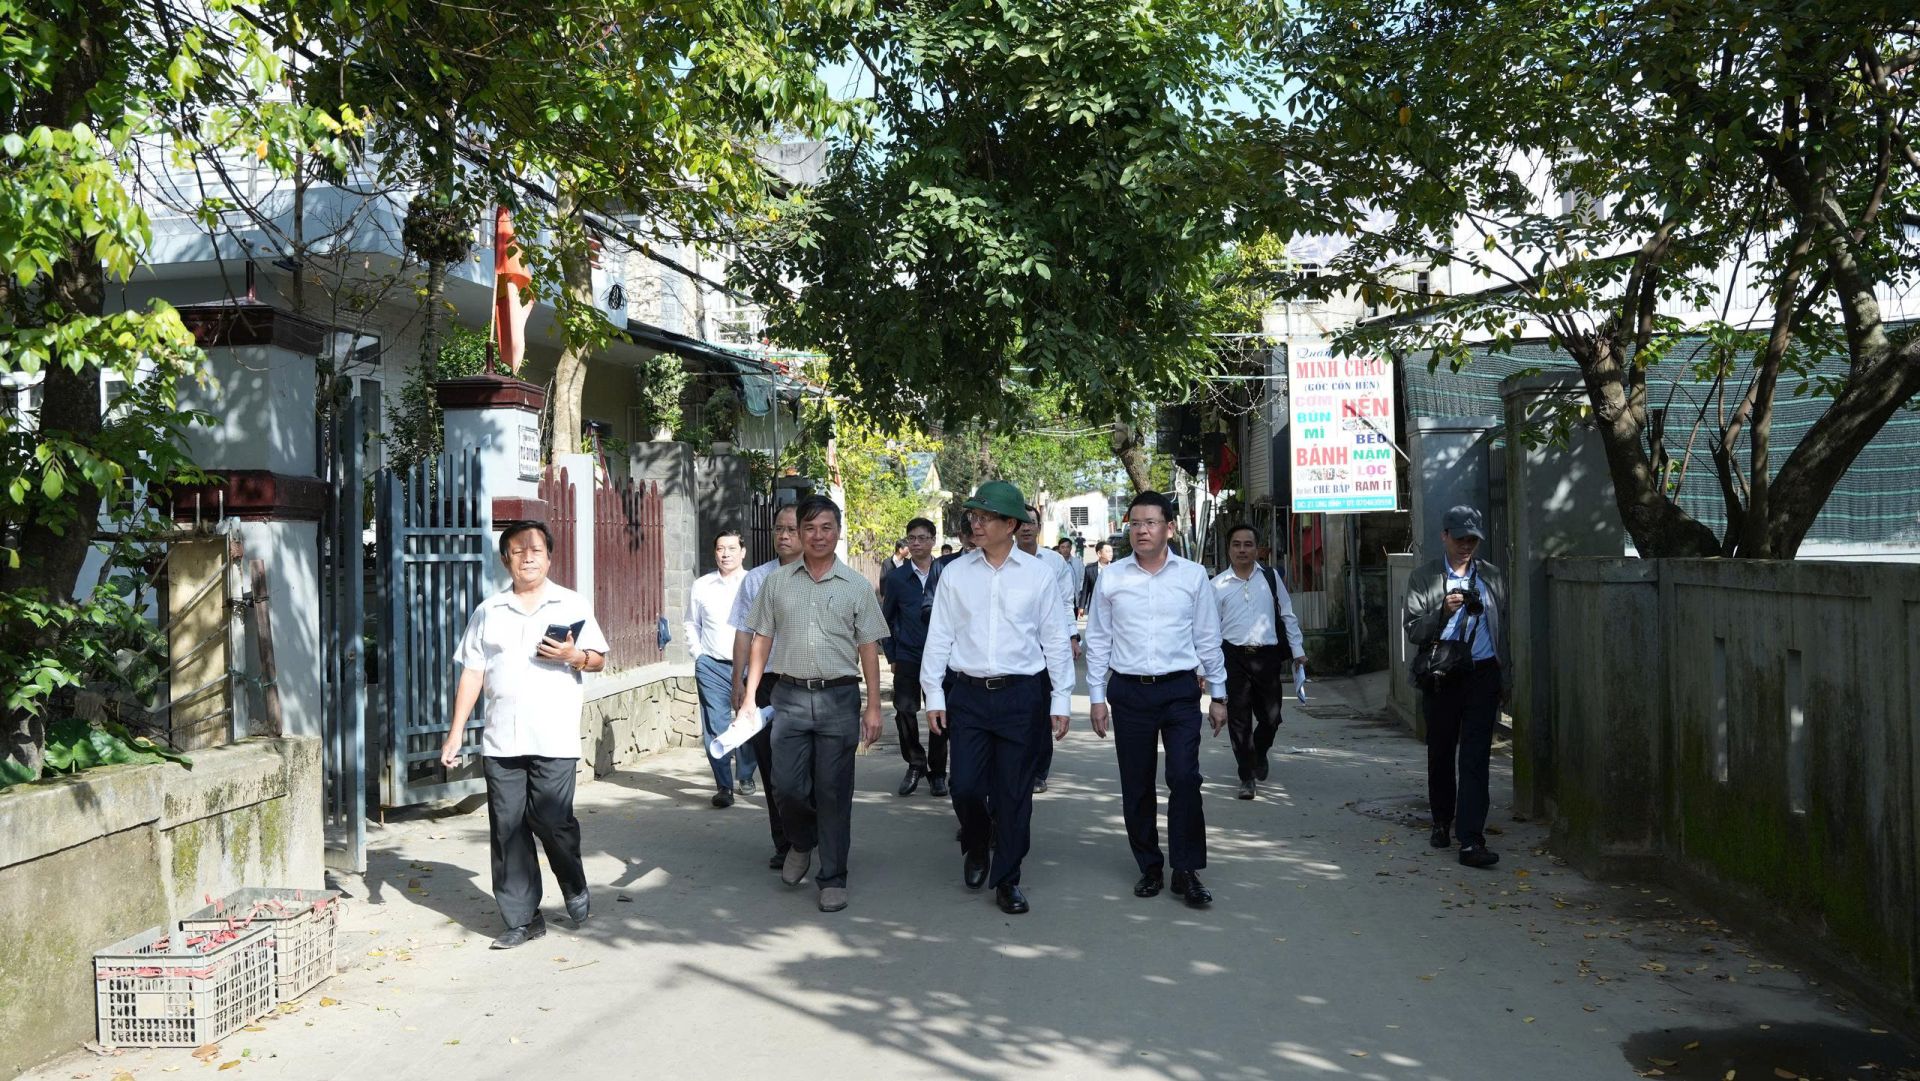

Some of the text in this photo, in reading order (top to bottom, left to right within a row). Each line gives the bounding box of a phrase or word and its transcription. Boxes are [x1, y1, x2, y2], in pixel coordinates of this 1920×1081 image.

[1296, 361, 1338, 379] MINH
[1342, 392, 1389, 418] HẾN
[1296, 443, 1348, 466] BÁNH
[1357, 465, 1387, 478] LỌC
[1355, 481, 1379, 491] RAM
